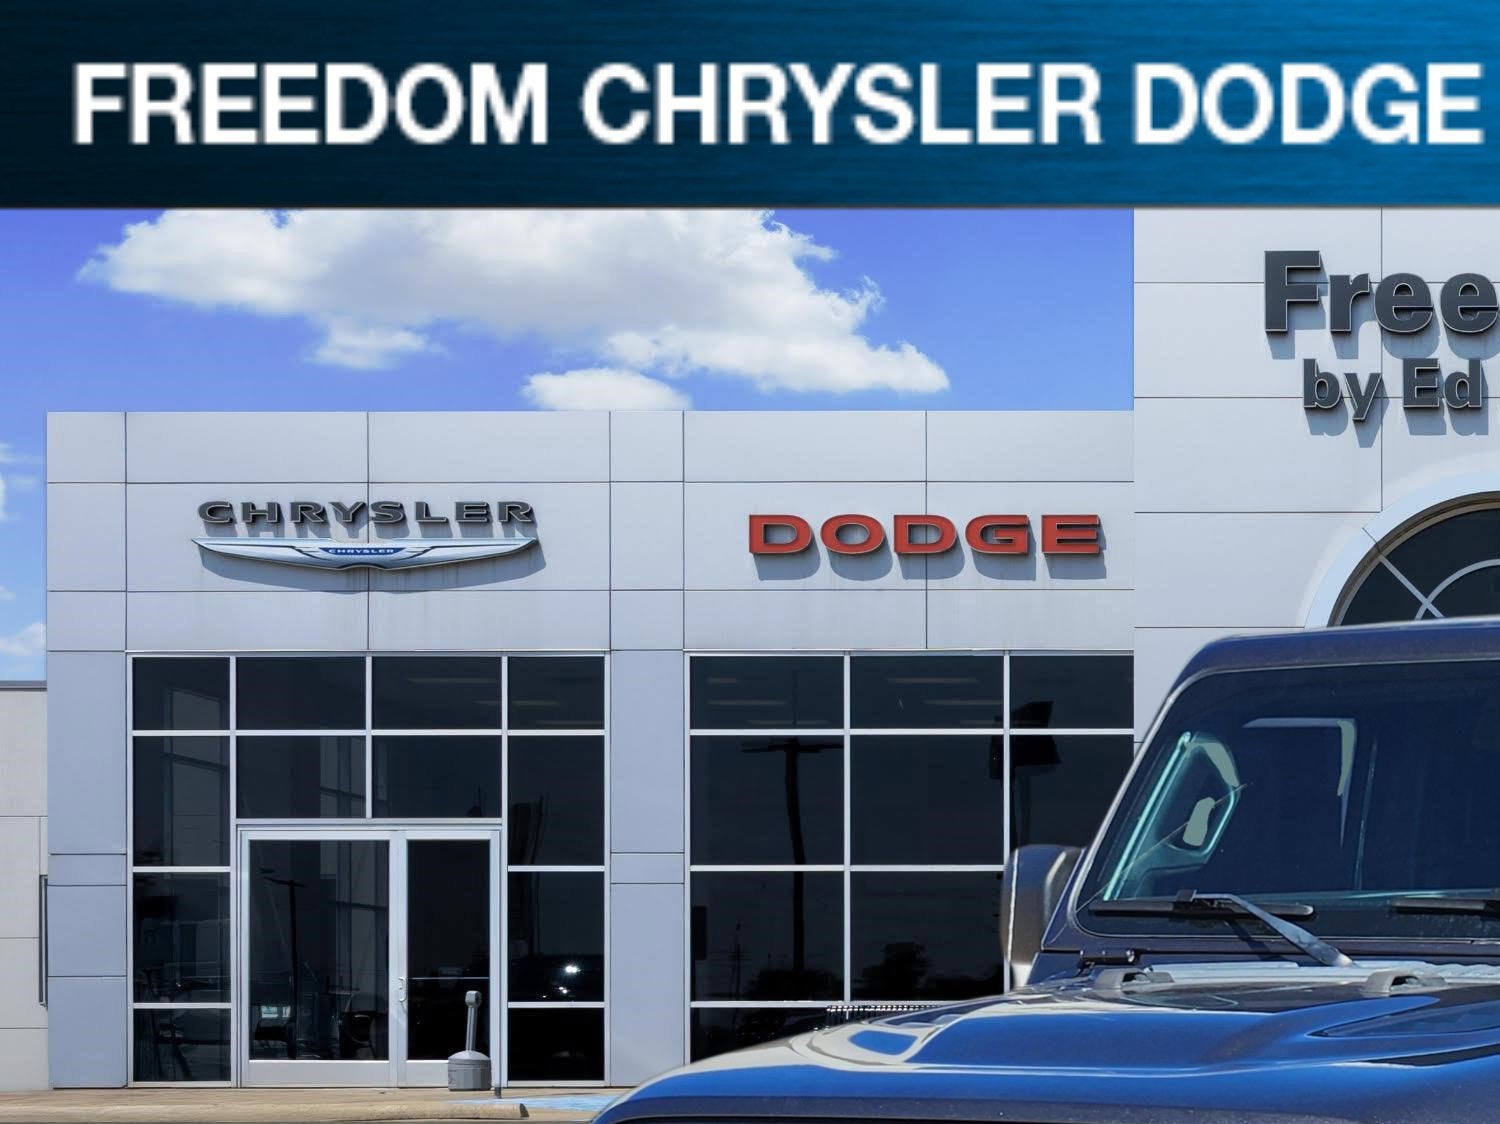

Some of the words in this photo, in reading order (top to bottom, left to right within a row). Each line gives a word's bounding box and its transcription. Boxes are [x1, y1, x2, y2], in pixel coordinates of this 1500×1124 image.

[1303, 358, 1383, 421] by
[1402, 358, 1483, 408] Ed
[198, 500, 536, 524] CHRYSLER
[749, 514, 1101, 554] DODGE
